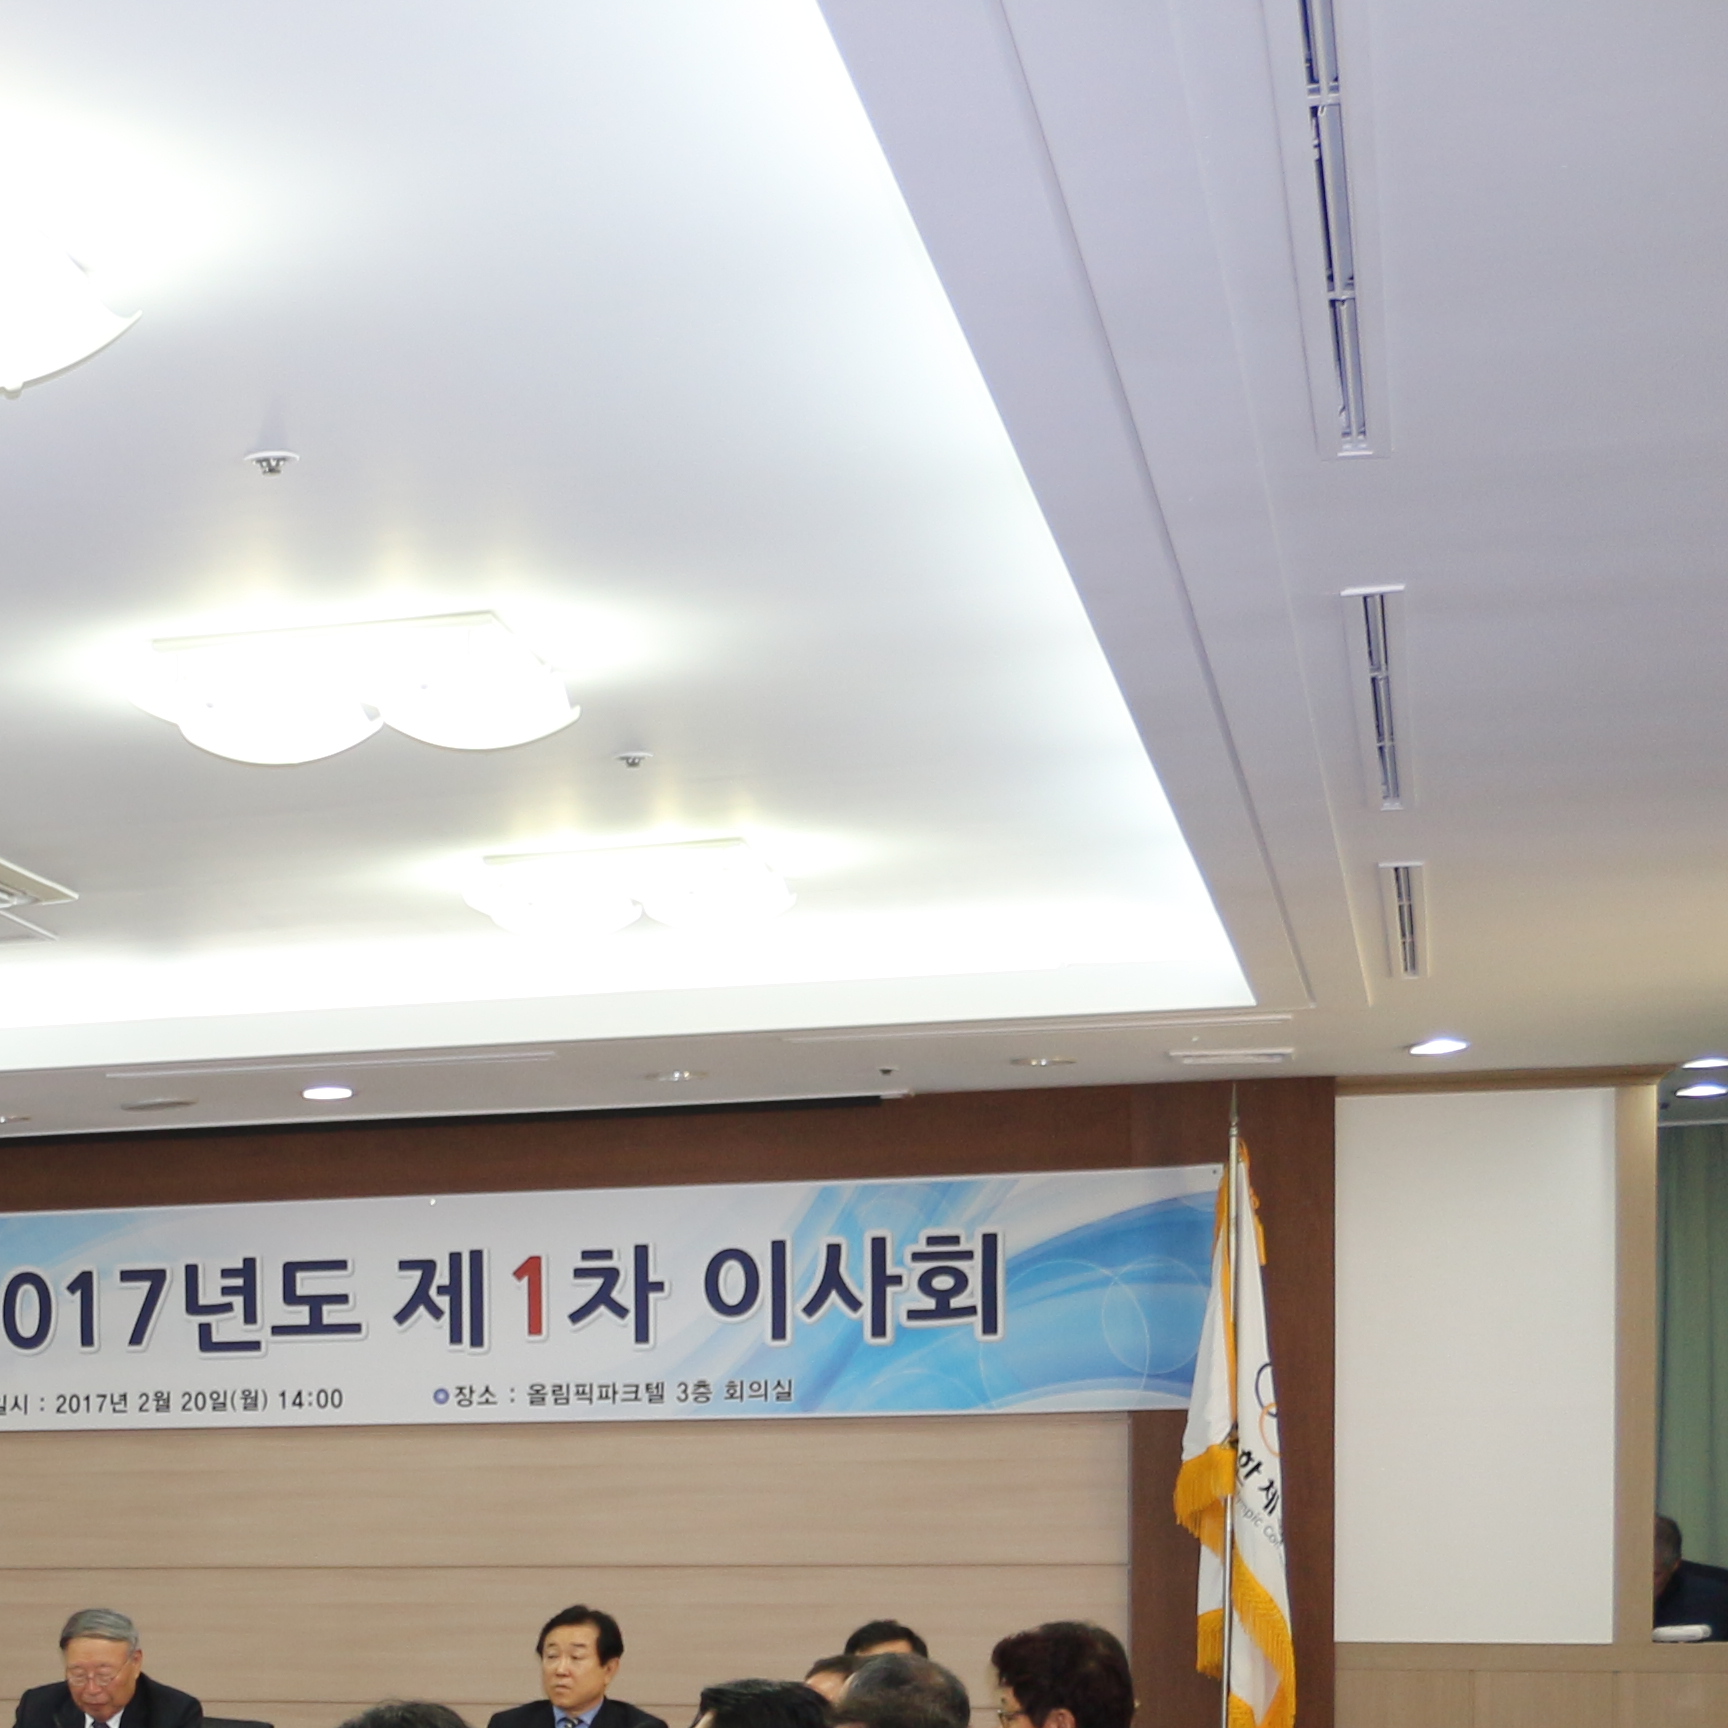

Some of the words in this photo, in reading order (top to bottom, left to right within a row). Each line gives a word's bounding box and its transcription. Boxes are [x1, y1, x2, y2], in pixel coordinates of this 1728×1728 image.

[704, 1233, 999, 1342] 이사회
[55, 1392, 131, 1415] 2017년
[138, 1391, 172, 1414] 2월
[181, 1388, 269, 1414] 20일(월)
[279, 1388, 343, 1409] 14:00
[454, 1384, 498, 1407] 장소
[527, 1381, 666, 1405] 올림픽파크텔
[676, 1381, 713, 1404] 3층
[724, 1378, 793, 1403] 회의실
